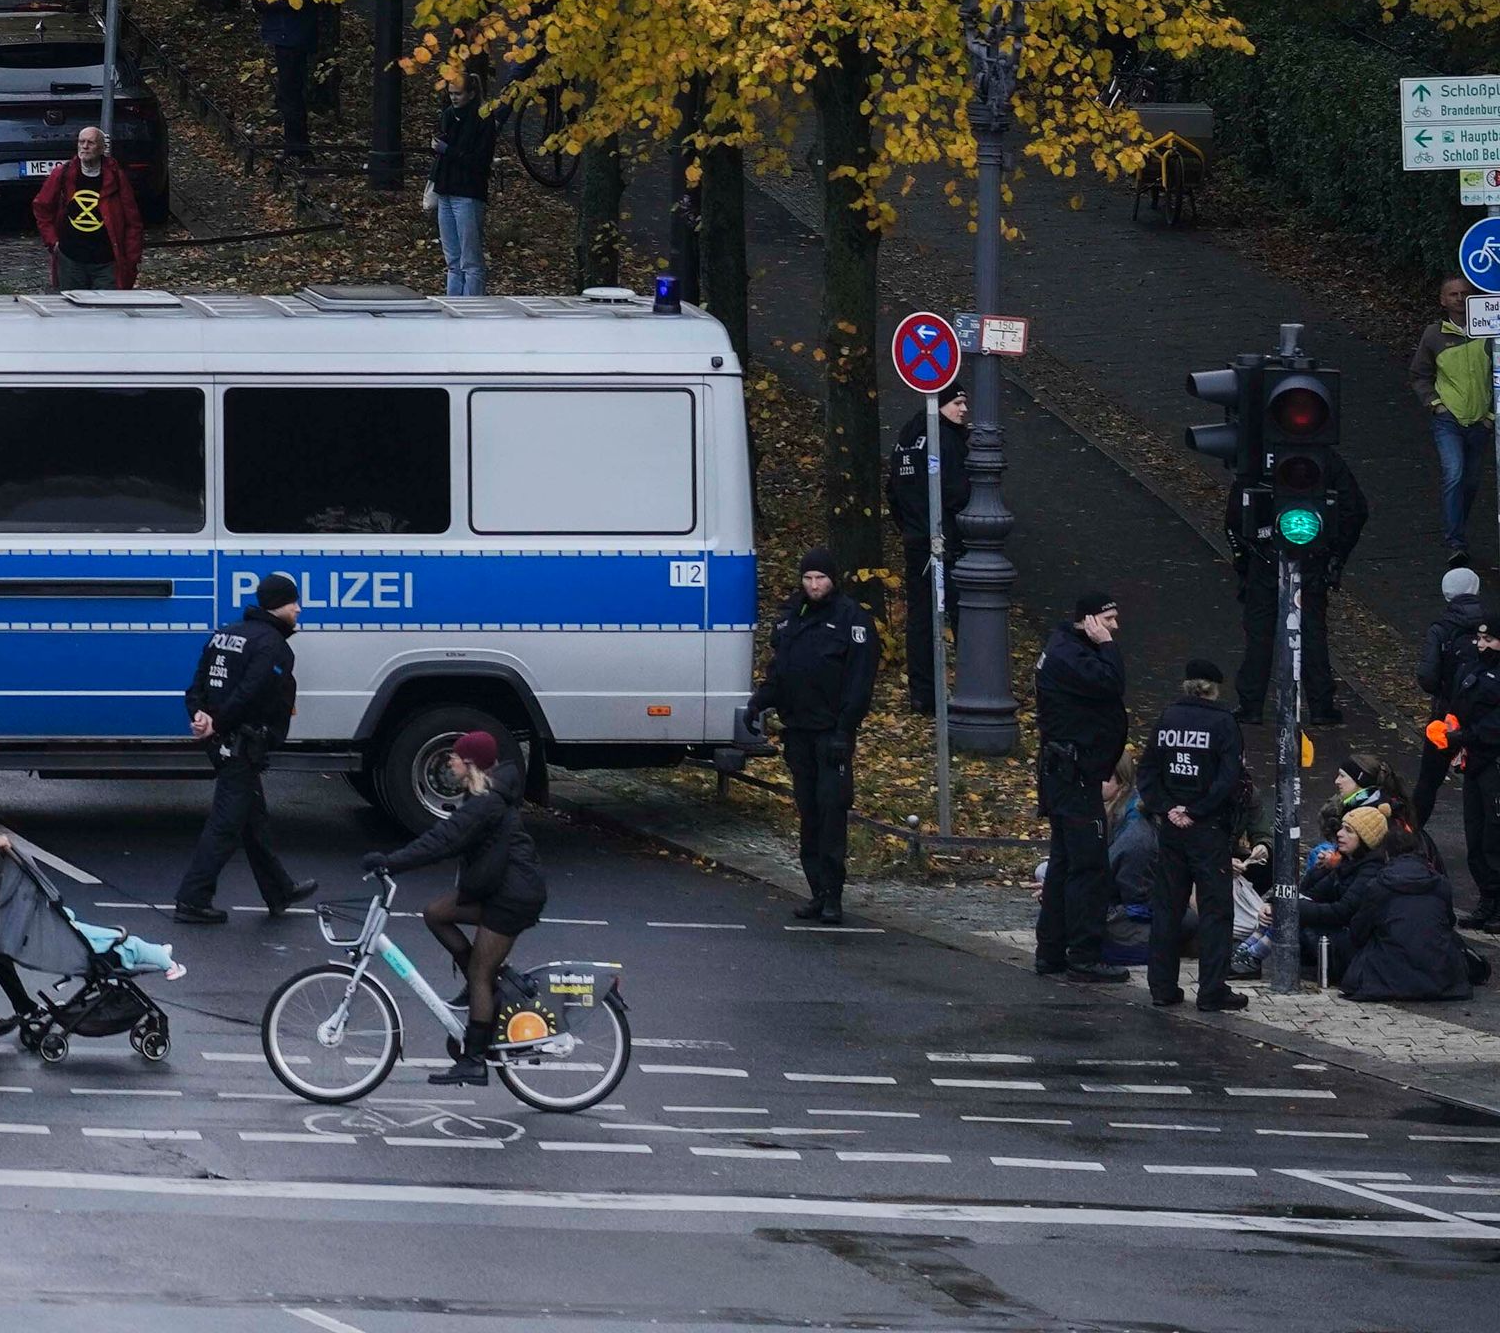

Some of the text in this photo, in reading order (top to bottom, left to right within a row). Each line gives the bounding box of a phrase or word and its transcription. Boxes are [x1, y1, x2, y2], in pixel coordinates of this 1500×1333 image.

[1443, 148, 1478, 162] Schloß
[31, 162, 47, 174] ME
[1485, 301, 1499, 311] Rad
[999, 322, 1014, 331] 150
[673, 564, 702, 584] 12
[232, 571, 414, 608] PLIZEI
[208, 632, 247, 653] POLIZEI
[215, 654, 225, 666] BE
[1158, 730, 1210, 749] POLIZEI
[1176, 753, 1191, 764] BE
[1169, 763, 1199, 777] 16237
